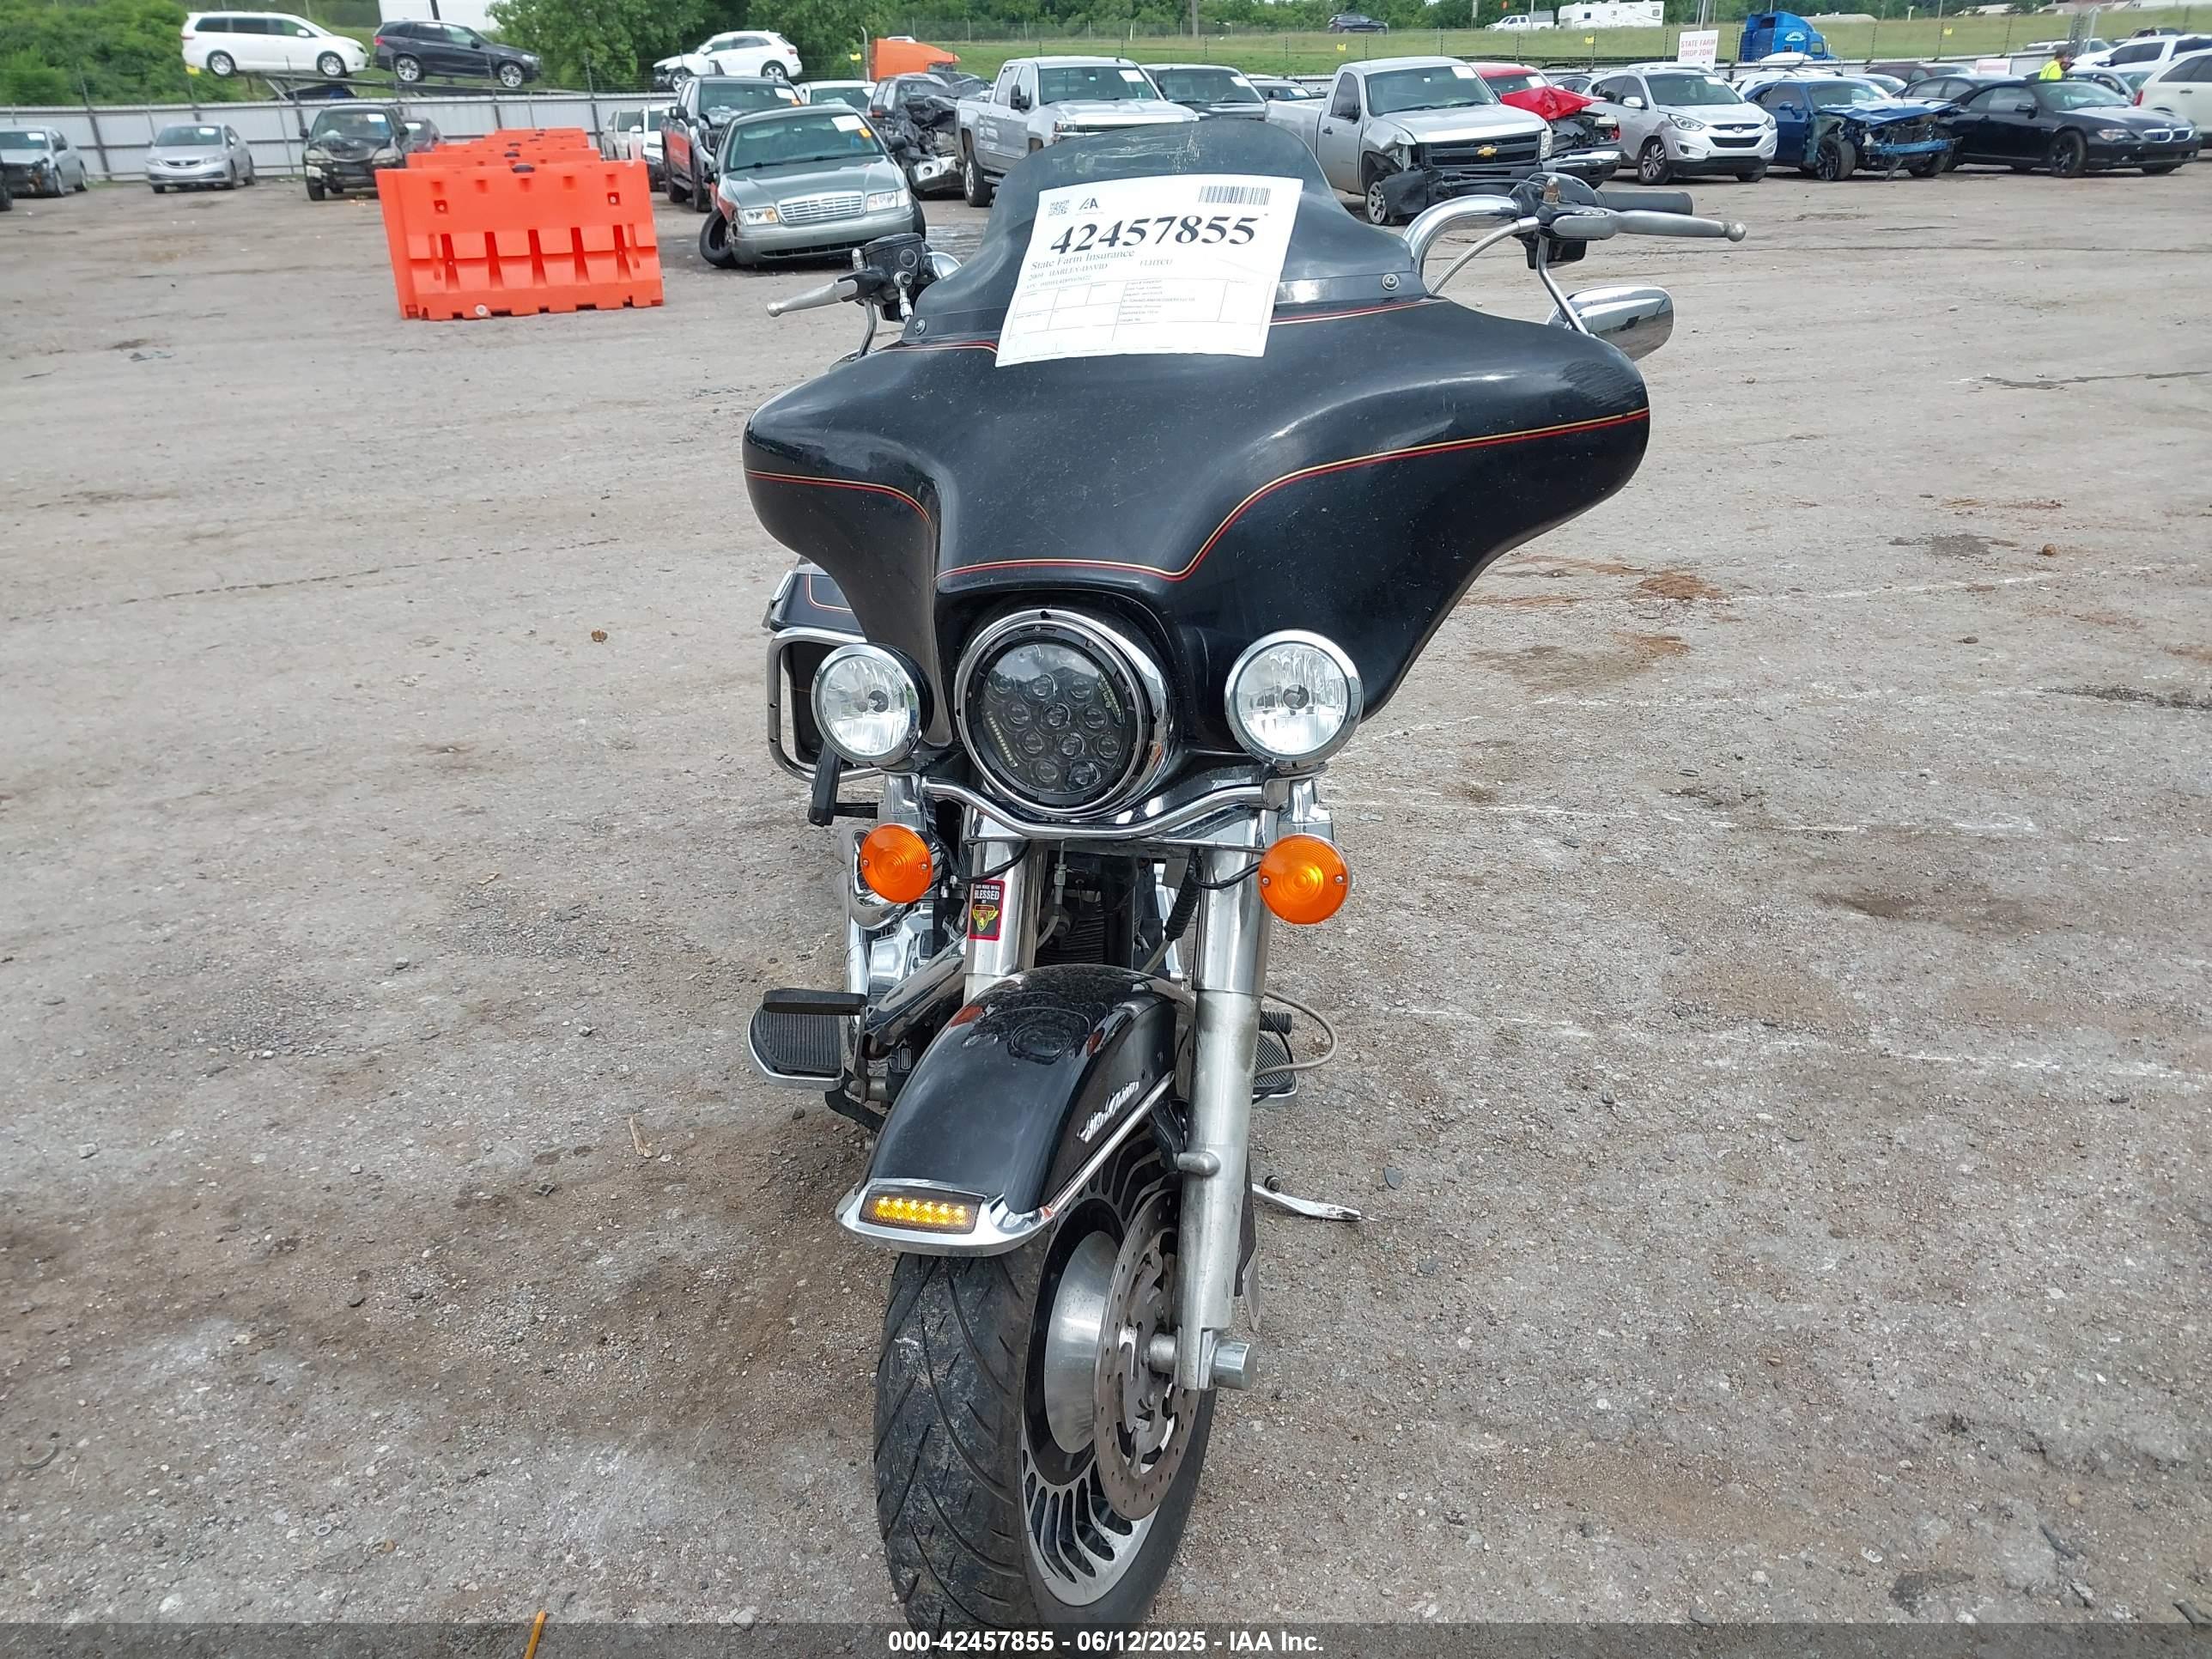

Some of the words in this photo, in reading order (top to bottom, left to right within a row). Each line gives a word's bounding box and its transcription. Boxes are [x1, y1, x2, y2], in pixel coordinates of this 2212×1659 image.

[1050, 216, 1259, 254] 42457855
[1057, 256, 1082, 265] Farm
[1085, 250, 1135, 261] Insurance
[974, 890, 1000, 901] BLESSED
